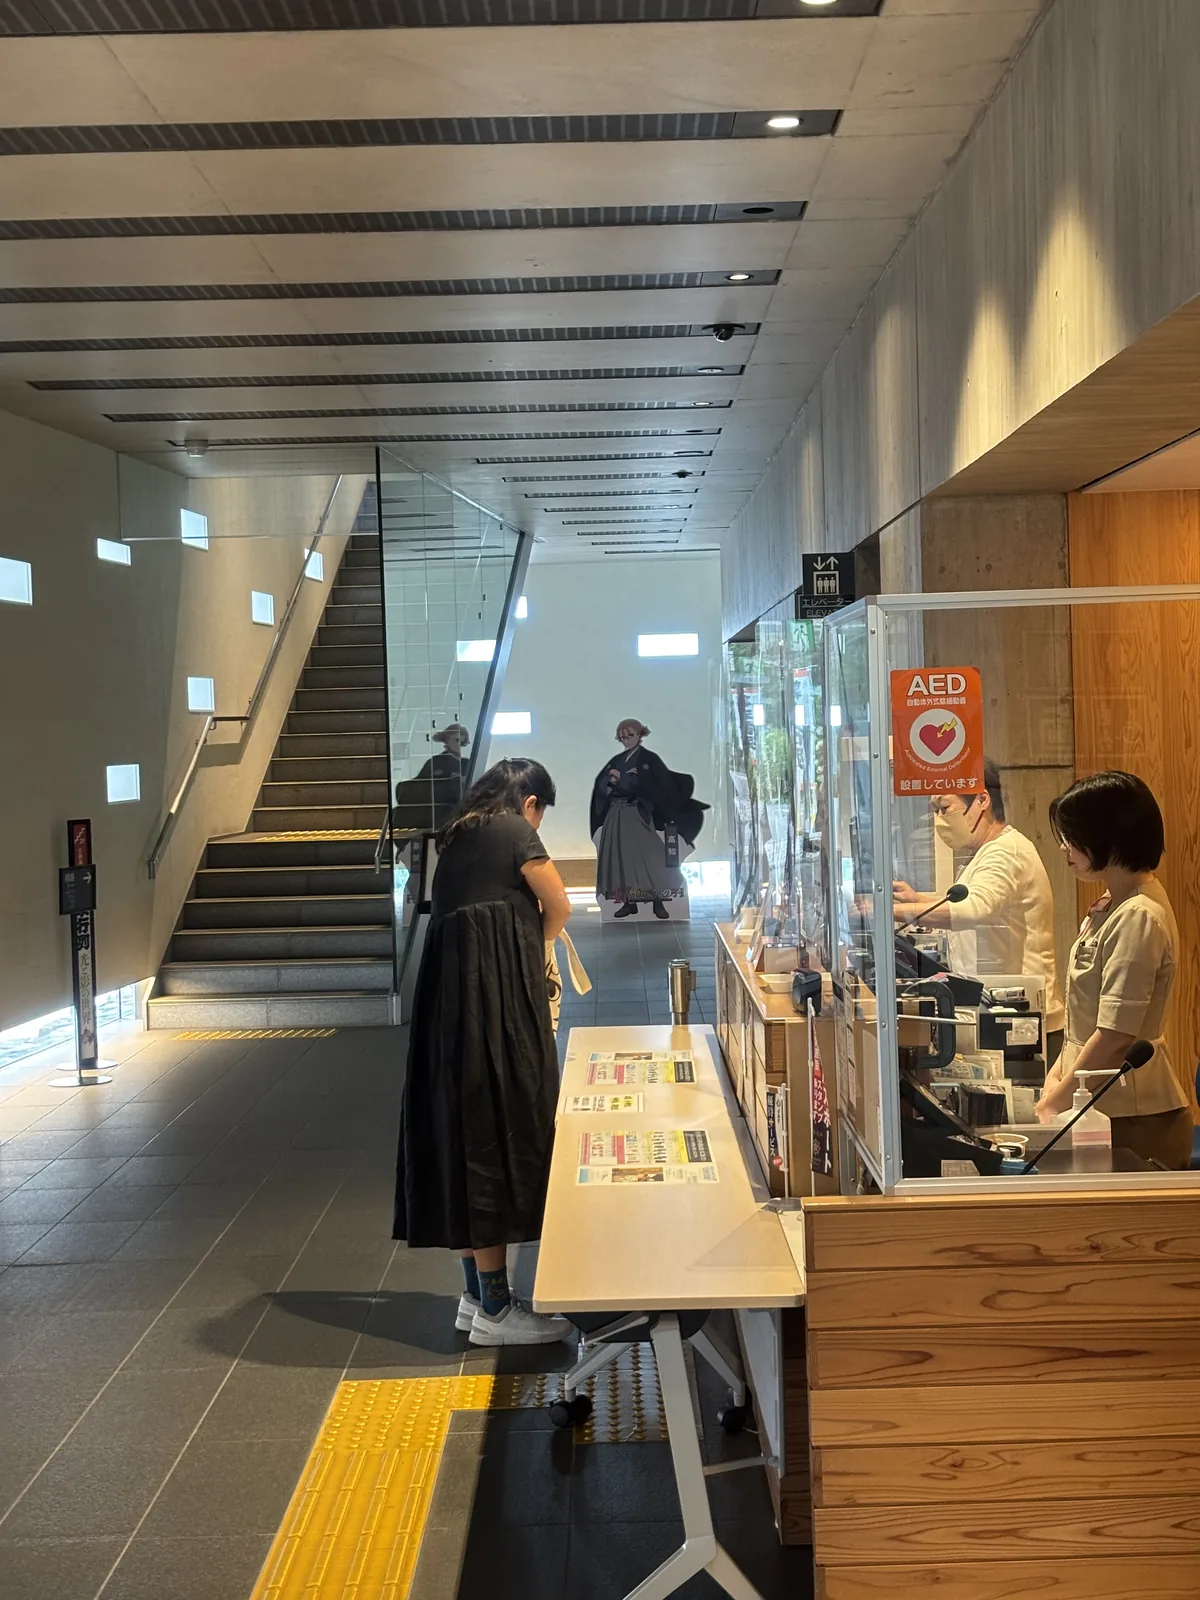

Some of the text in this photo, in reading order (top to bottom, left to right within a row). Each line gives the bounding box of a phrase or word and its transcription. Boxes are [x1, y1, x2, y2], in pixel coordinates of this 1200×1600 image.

[802, 597, 853, 607] エレベーター
[806, 609, 837, 618] ELEVA
[907, 673, 967, 697] AED
[904, 748, 927, 770] Automated
[948, 746, 971, 770] Defibrillator
[900, 777, 978, 791] 設置しています
[667, 835, 676, 856] 高知
